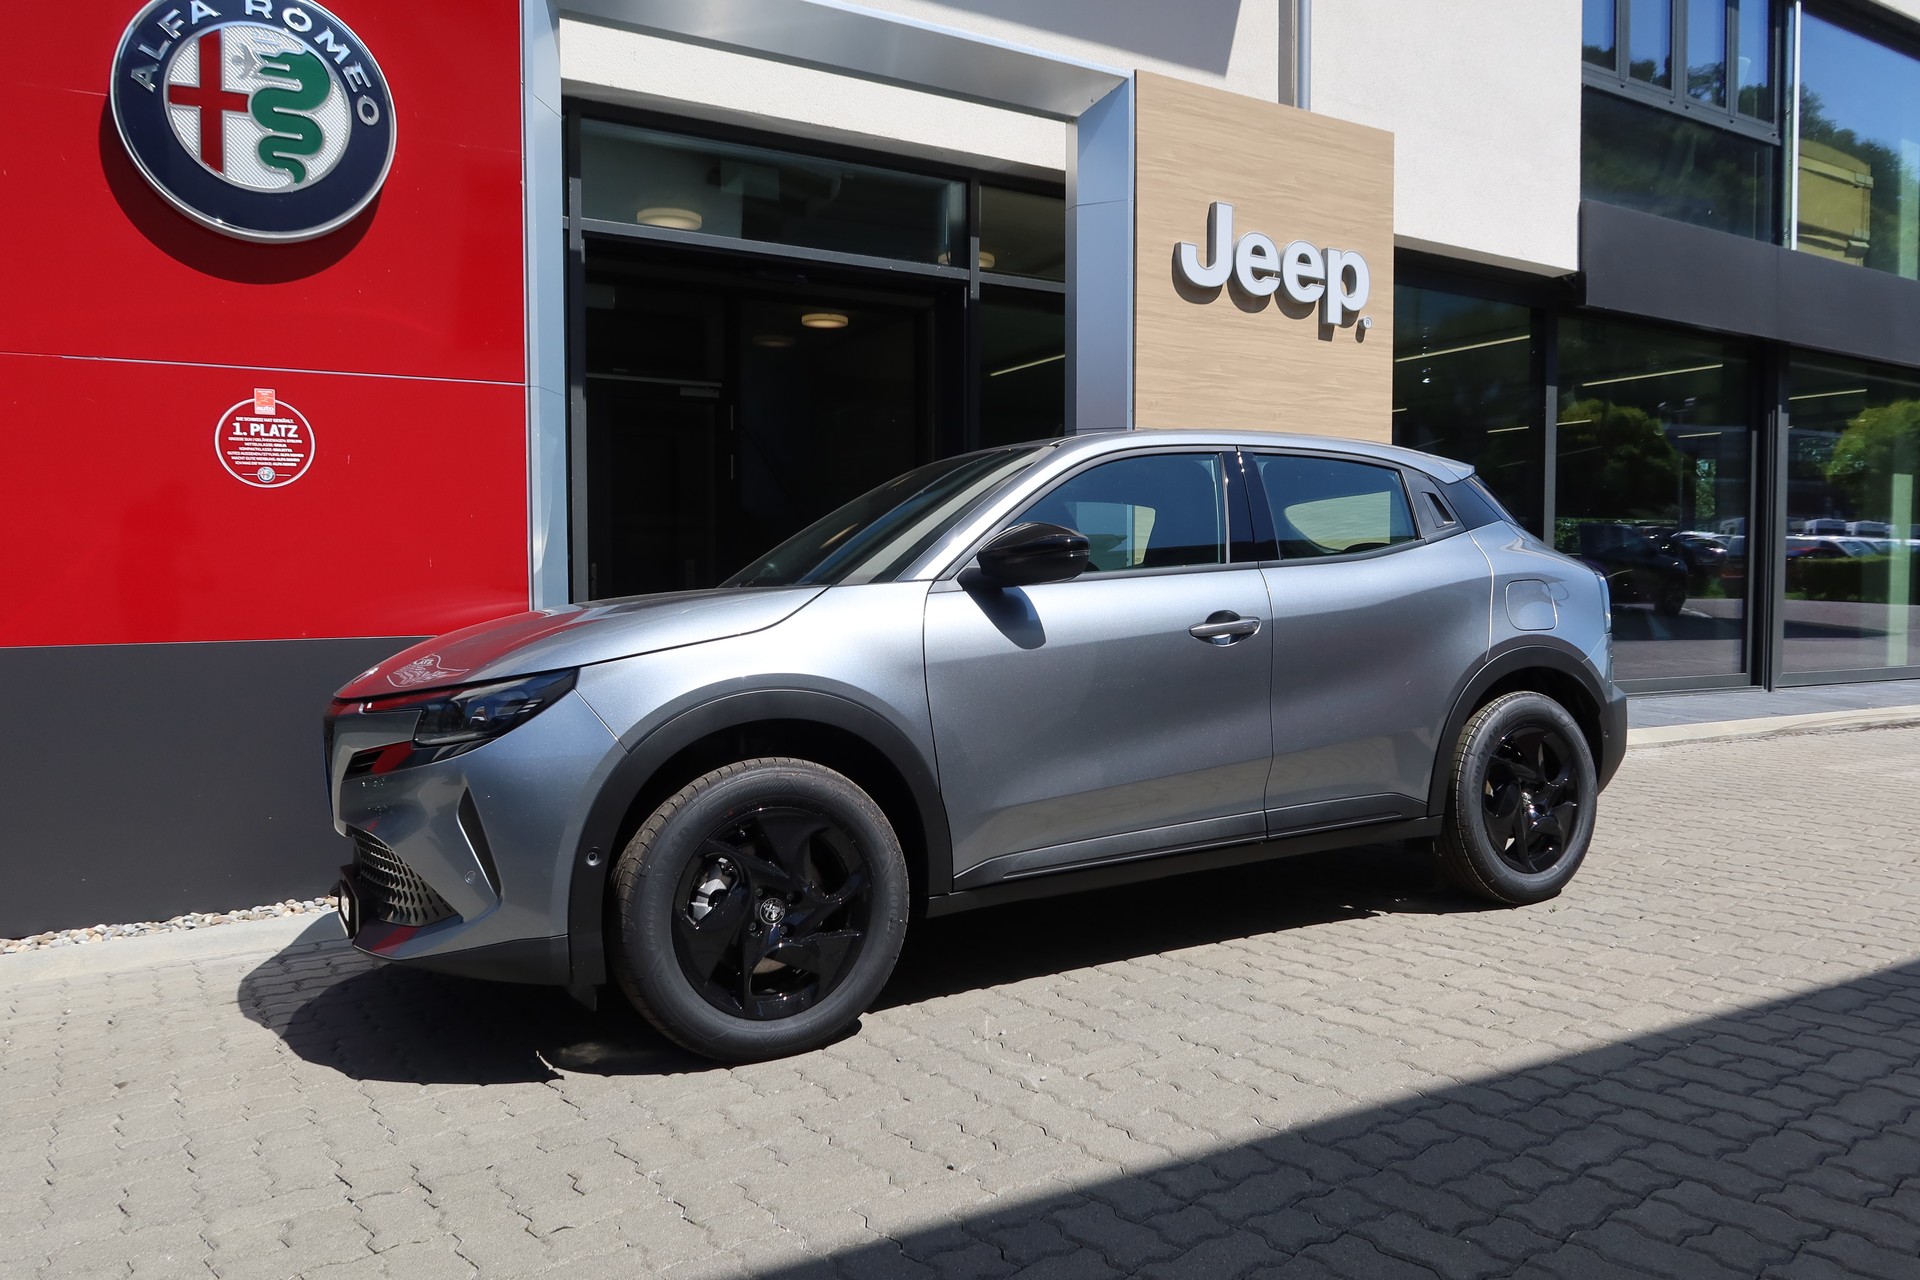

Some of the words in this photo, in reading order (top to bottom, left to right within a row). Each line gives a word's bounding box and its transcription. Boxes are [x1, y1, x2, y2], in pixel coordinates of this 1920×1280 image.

[130, 0, 222, 93] ALFA
[244, 0, 380, 126] ROMEO
[1174, 201, 1370, 325] Jeep
[232, 422, 248, 436] 1.
[250, 423, 299, 438] PLATZ
